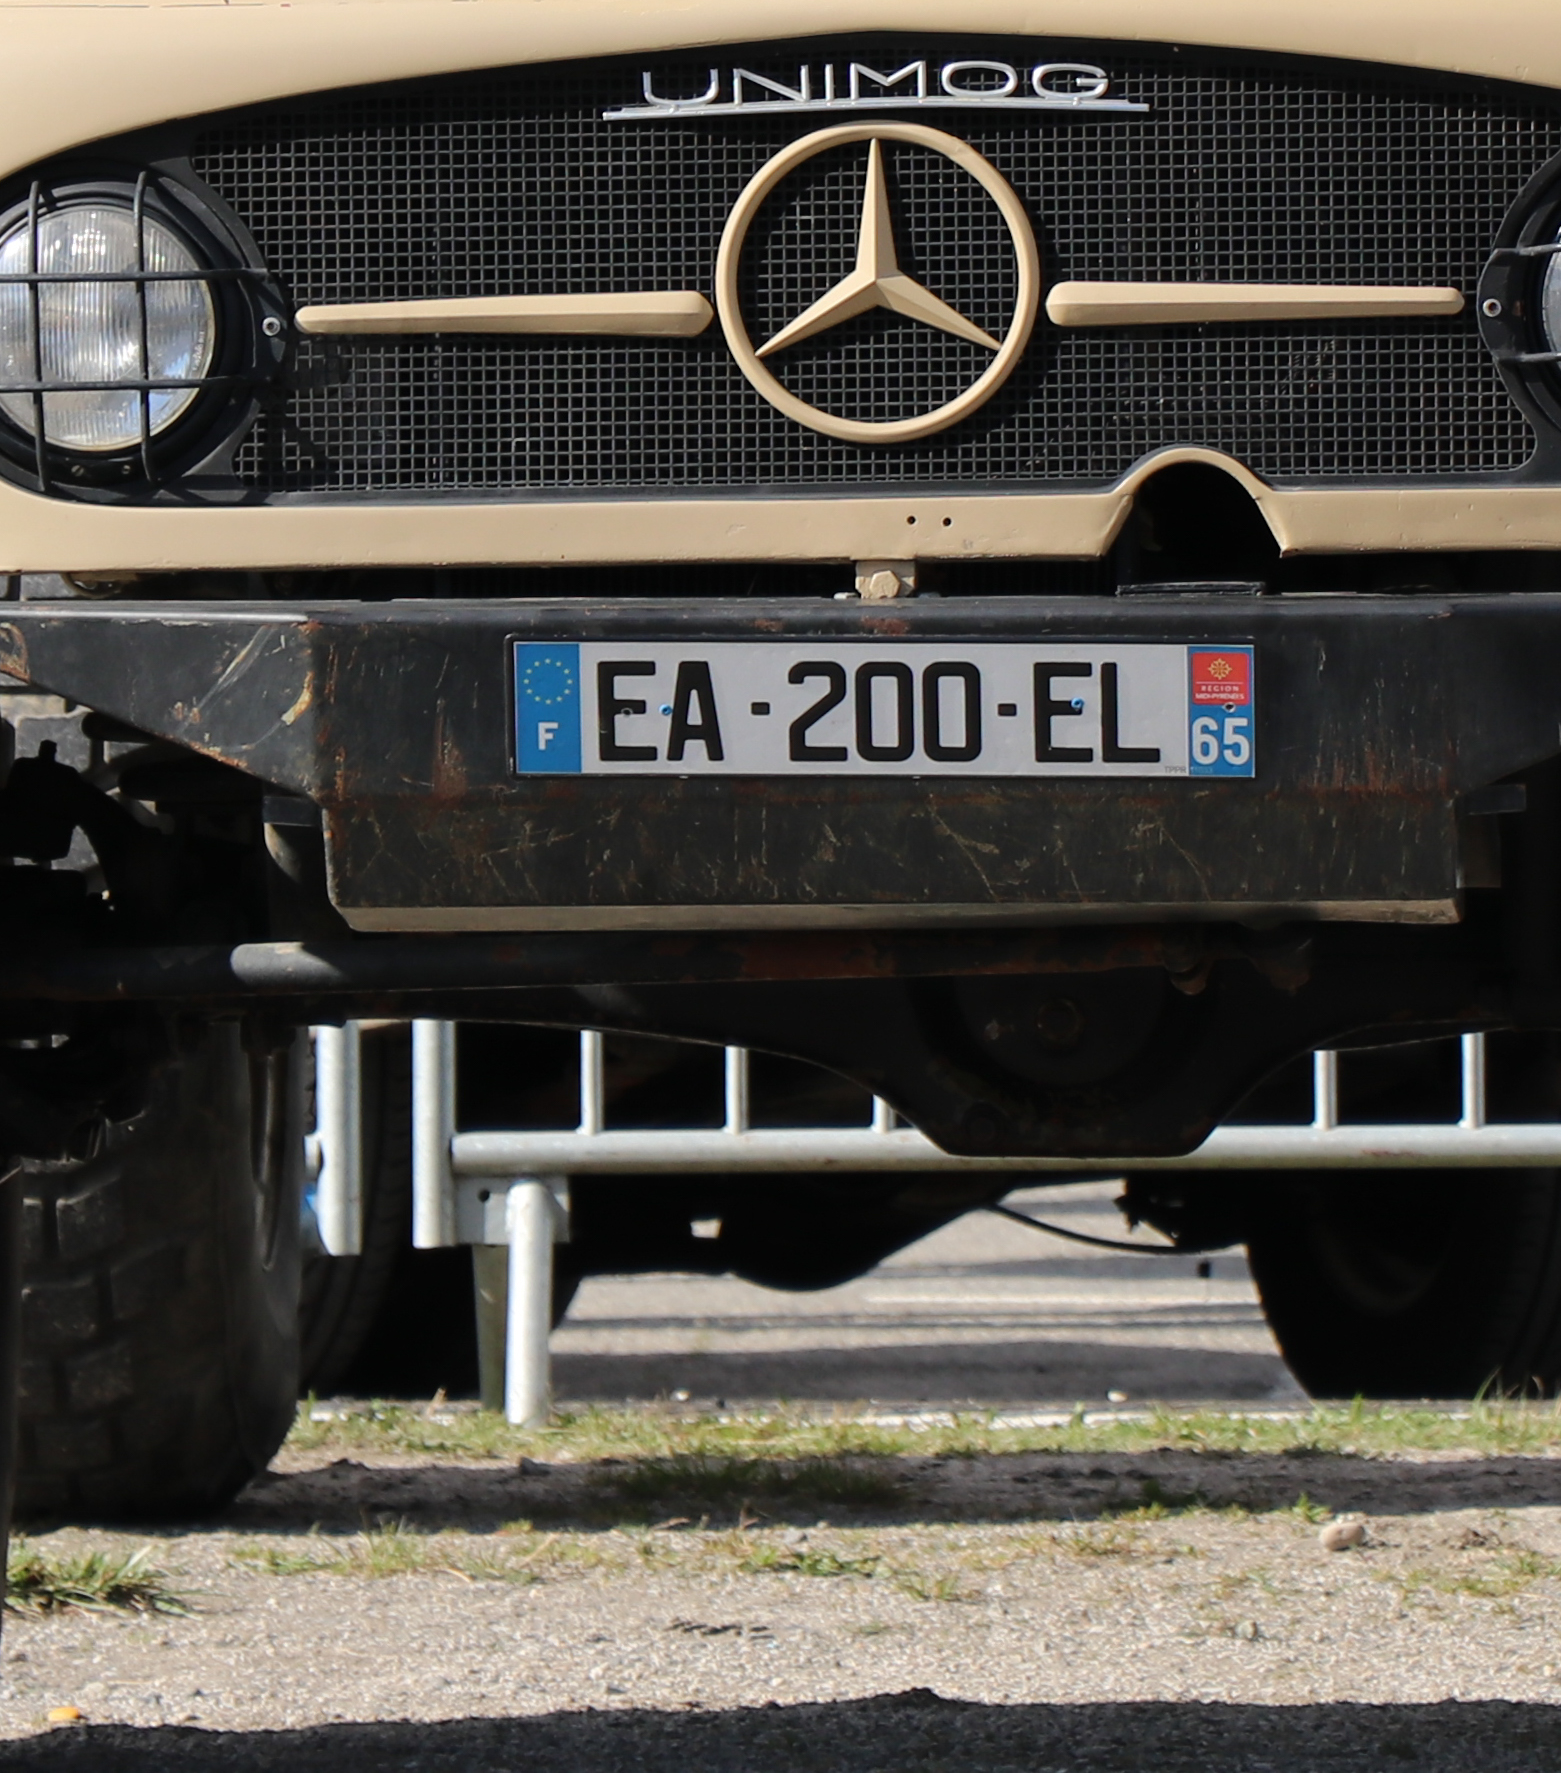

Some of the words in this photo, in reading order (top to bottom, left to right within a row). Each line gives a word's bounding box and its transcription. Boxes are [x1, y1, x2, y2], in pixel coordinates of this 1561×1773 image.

[643, 60, 1107, 108] UNIMOG
[597, 661, 1160, 762] EA-200-EL
[538, 722, 558, 750] F
[1192, 716, 1251, 765] 65
